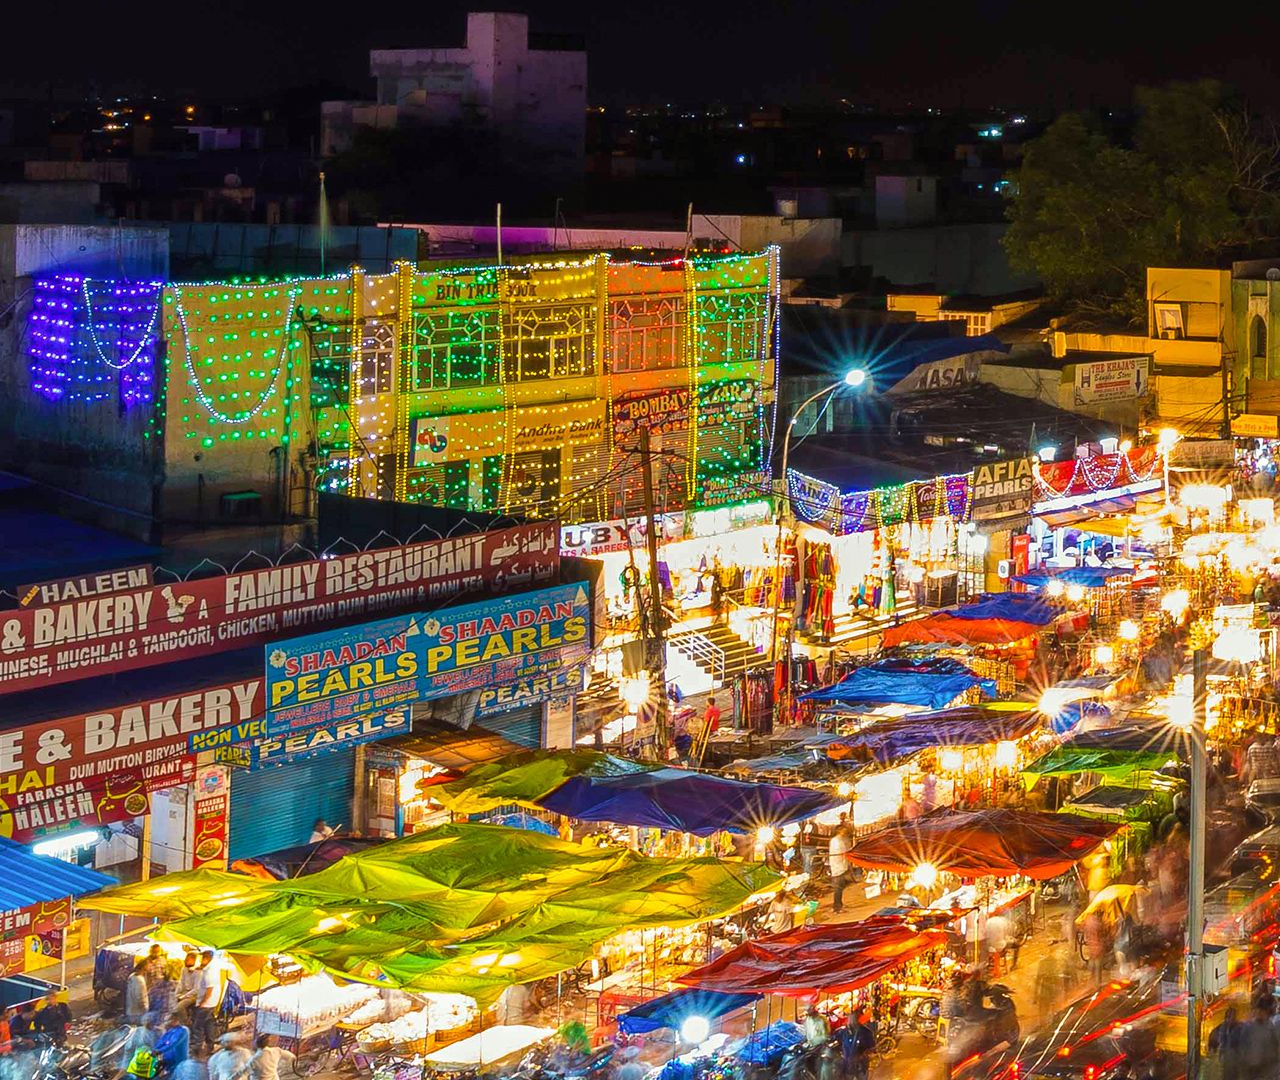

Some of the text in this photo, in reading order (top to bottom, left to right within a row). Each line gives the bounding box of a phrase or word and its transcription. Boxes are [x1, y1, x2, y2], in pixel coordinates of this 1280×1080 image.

[436, 284, 460, 300] BIN
[1090, 364, 1105, 374] THE
[629, 392, 688, 419] BOMBAY
[974, 477, 1032, 498] PEARLS
[975, 458, 1032, 485] AFIA
[561, 522, 636, 548] UBY
[41, 568, 148, 604] HALEEM
[225, 535, 487, 615] FAMILY RESTAURANT
[1, 619, 25, 654] &
[34, 591, 153, 649] BAKERY
[198, 599, 208, 620] A
[57, 643, 124, 671] MUGHLAI
[129, 639, 138, 656] &
[141, 623, 215, 655] TANDOORI,
[218, 613, 280, 641] CHICKEN,
[283, 602, 335, 627] MUTTON
[338, 598, 365, 619] DUM
[368, 590, 414, 614] BIRYANI
[417, 584, 427, 601] &
[429, 579, 462, 600] IRANI
[439, 600, 575, 644] SHAADAN
[285, 633, 407, 677] SHAADAN
[427, 616, 587, 674] PEARLS
[272, 652, 418, 707] PEARLS
[479, 670, 582, 708] PEARLS
[36, 729, 72, 765] &
[84, 680, 260, 755] BAKERY
[193, 729, 231, 750] NON
[259, 711, 406, 760] PEARLS
[69, 763, 96, 780] DUM
[97, 752, 143, 774] MUTTON
[145, 742, 187, 766] BIRYANI
[15, 792, 95, 830] HALEEM
[17, 781, 85, 805] FARASHA
[197, 803, 225, 815] HALEEM
